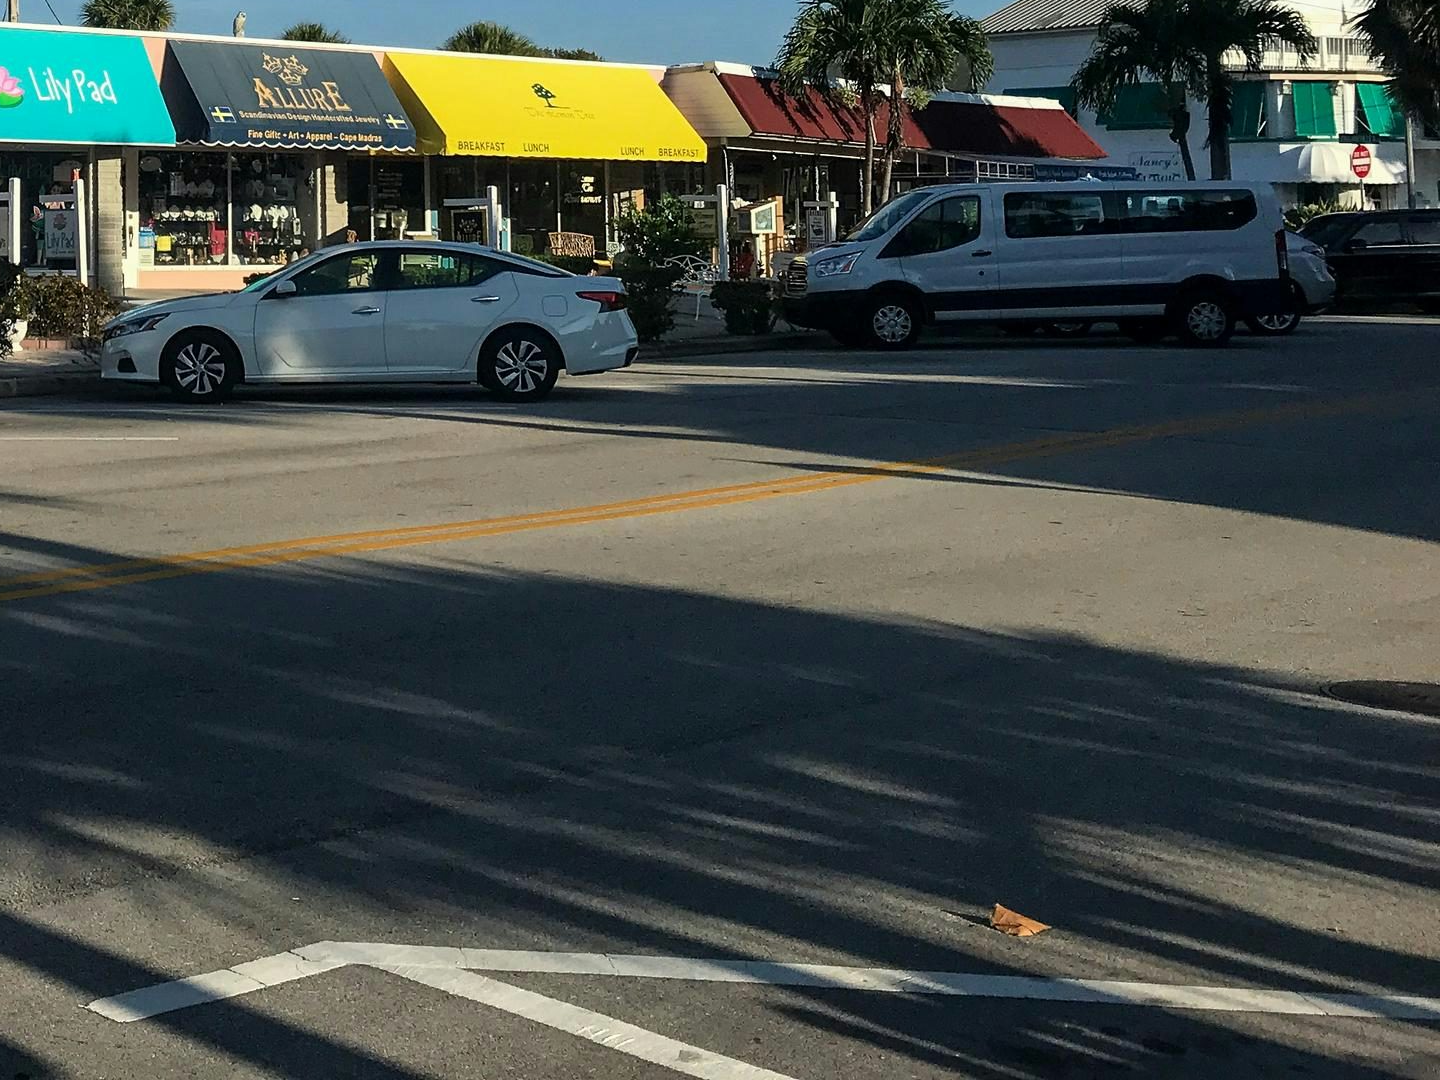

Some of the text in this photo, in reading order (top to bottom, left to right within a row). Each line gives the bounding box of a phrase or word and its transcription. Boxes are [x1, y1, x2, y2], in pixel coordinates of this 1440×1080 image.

[252, 77, 352, 112] ALLURE
[238, 110, 380, 125] Scandinavian Design Handcrafted Jewelry
[247, 129, 263, 139] Fine
[288, 131, 300, 140] Art
[306, 131, 333, 142] Apparel
[339, 132, 357, 143] Cape
[358, 133, 382, 142] Madras
[458, 140, 700, 157] BREAKFAST LUNCH LUNCH BREAKFAST
